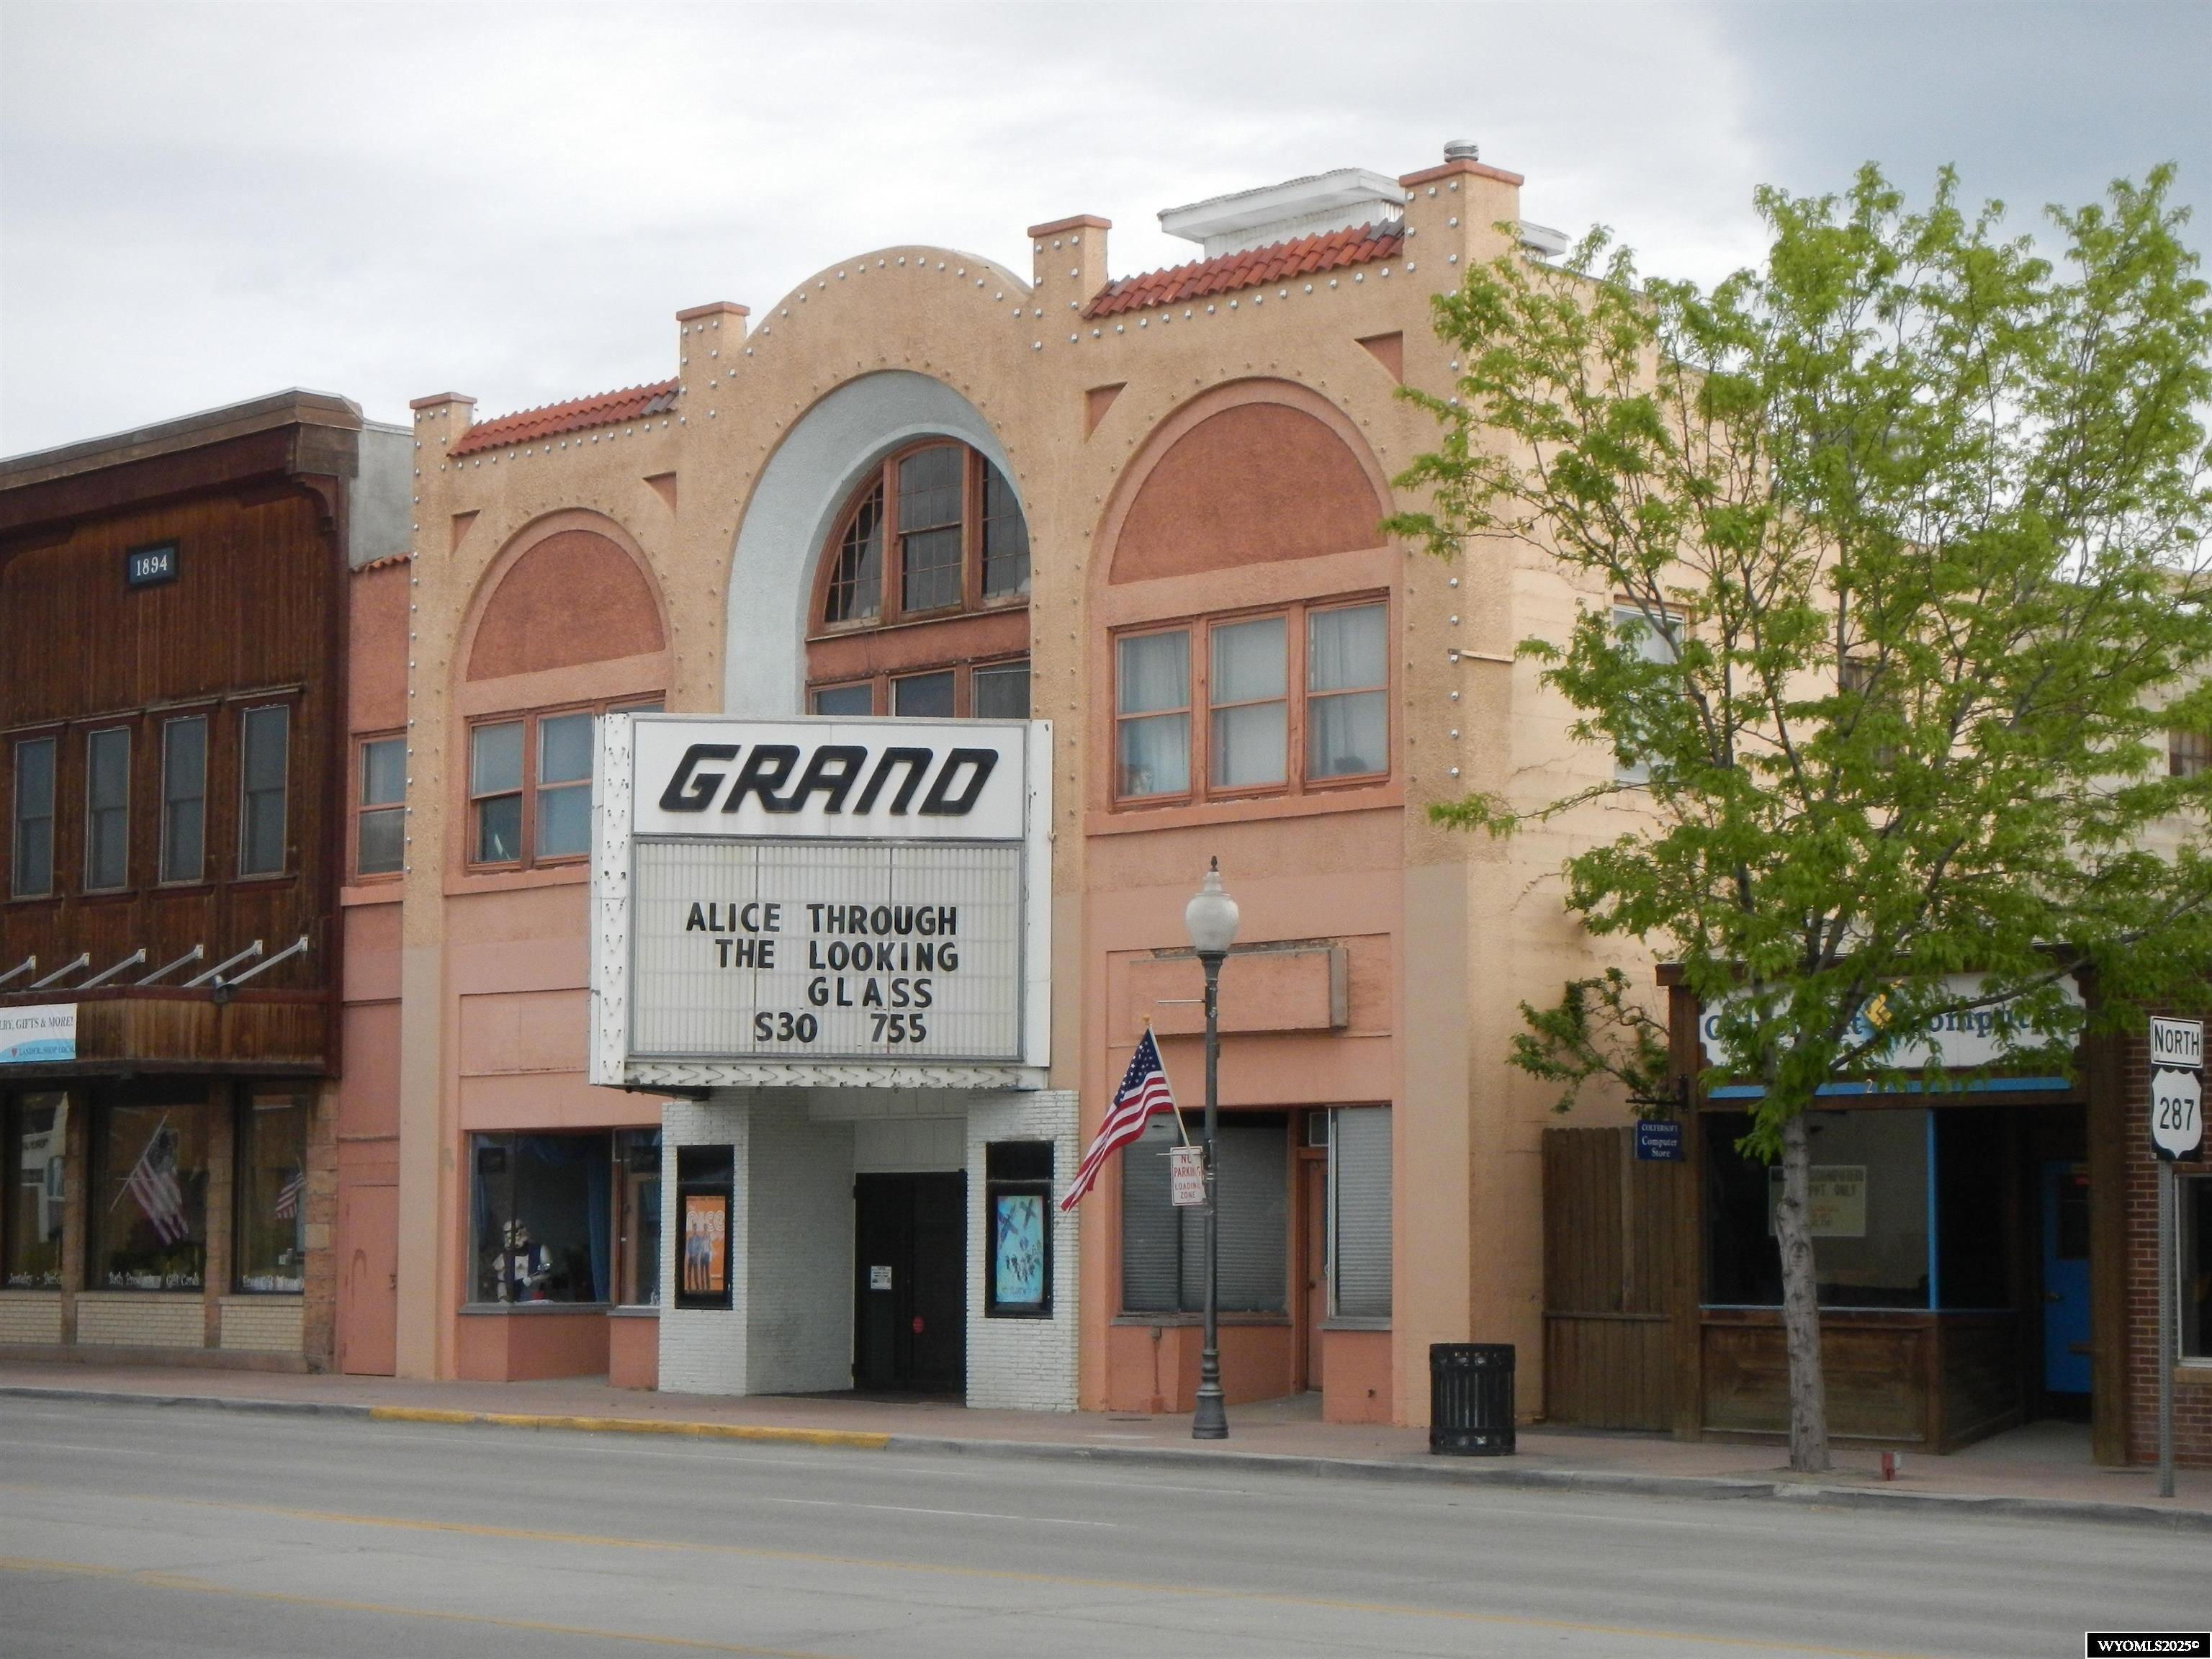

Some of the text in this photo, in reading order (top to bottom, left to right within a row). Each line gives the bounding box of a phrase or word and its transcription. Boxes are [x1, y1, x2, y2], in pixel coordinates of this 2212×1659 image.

[137, 554, 168, 576] 1894
[659, 743, 999, 817] GRAND
[686, 902, 957, 935] ALICE THROUGH
[715, 938, 958, 971] THE LOOKING
[808, 976, 932, 1008] GLASS
[16, 1017, 39, 1030] GIFTS
[40, 1018, 46, 1028] &
[48, 1016, 73, 1027] MORE!
[871, 1013, 927, 1043] 755
[2154, 1024, 2200, 1056] NORTH
[2160, 1097, 2195, 1130] 287
[1642, 1136, 1678, 1148] Computer
[1652, 1147, 1671, 1158] Store
[1174, 1166, 1201, 1177] PARKING
